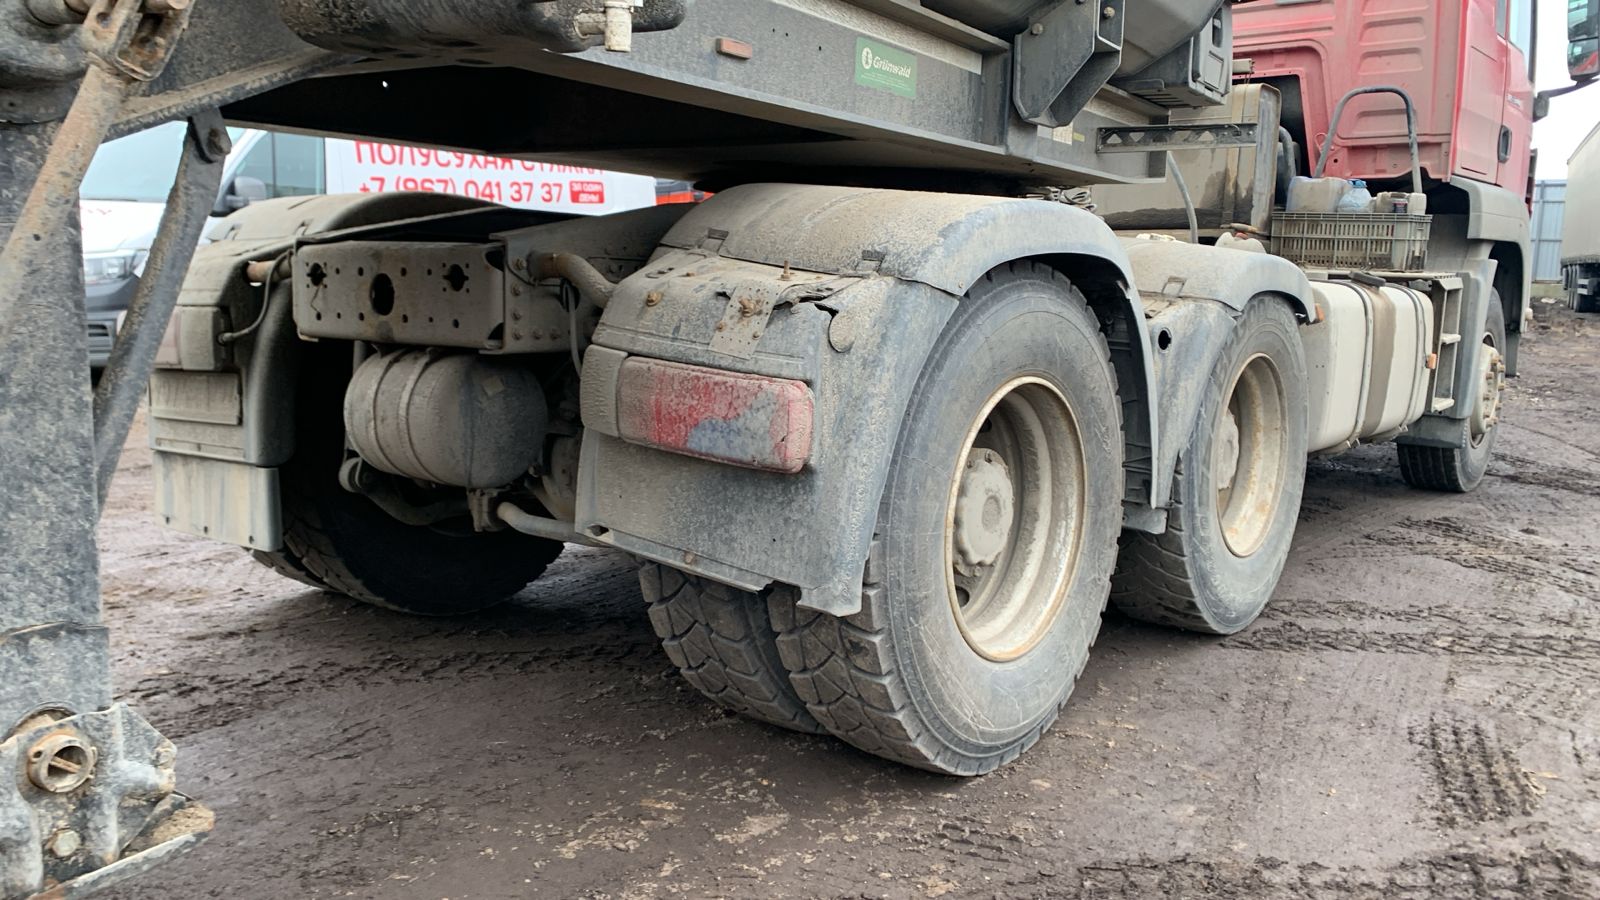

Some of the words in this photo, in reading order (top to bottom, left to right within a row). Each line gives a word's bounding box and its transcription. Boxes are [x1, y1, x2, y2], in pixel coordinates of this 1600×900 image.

[873, 56, 911, 78] Grünwald
[464, 179, 502, 204] 041
[509, 181, 534, 203] 37
[541, 182, 563, 203] 37
